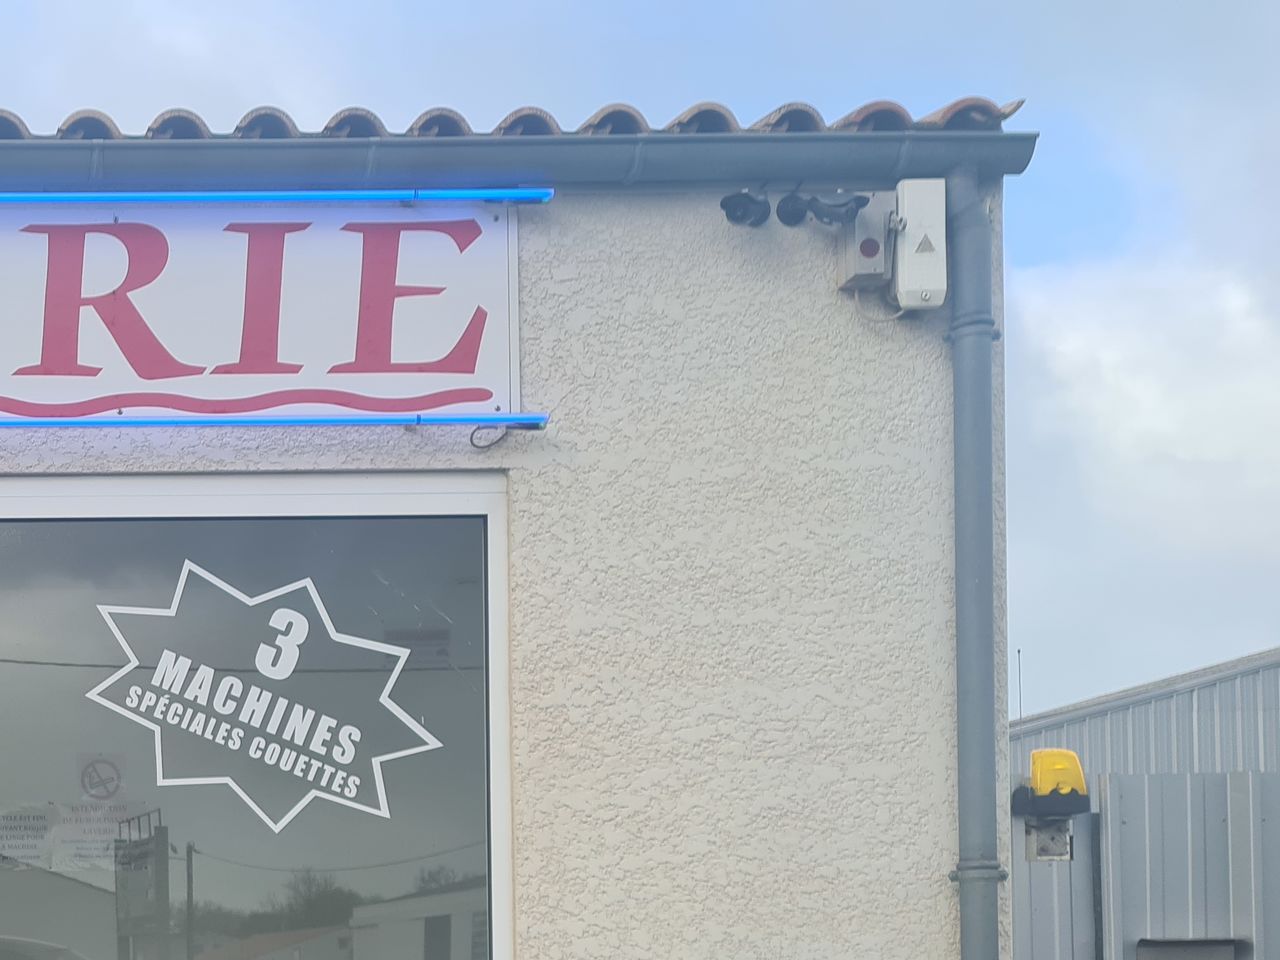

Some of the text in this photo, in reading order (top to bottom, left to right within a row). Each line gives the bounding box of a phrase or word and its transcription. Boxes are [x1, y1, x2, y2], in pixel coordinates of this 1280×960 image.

[255, 608, 309, 680] 3
[125, 685, 361, 799] SPÉCIALES COUETTES
[151, 649, 361, 765] MACHINES
